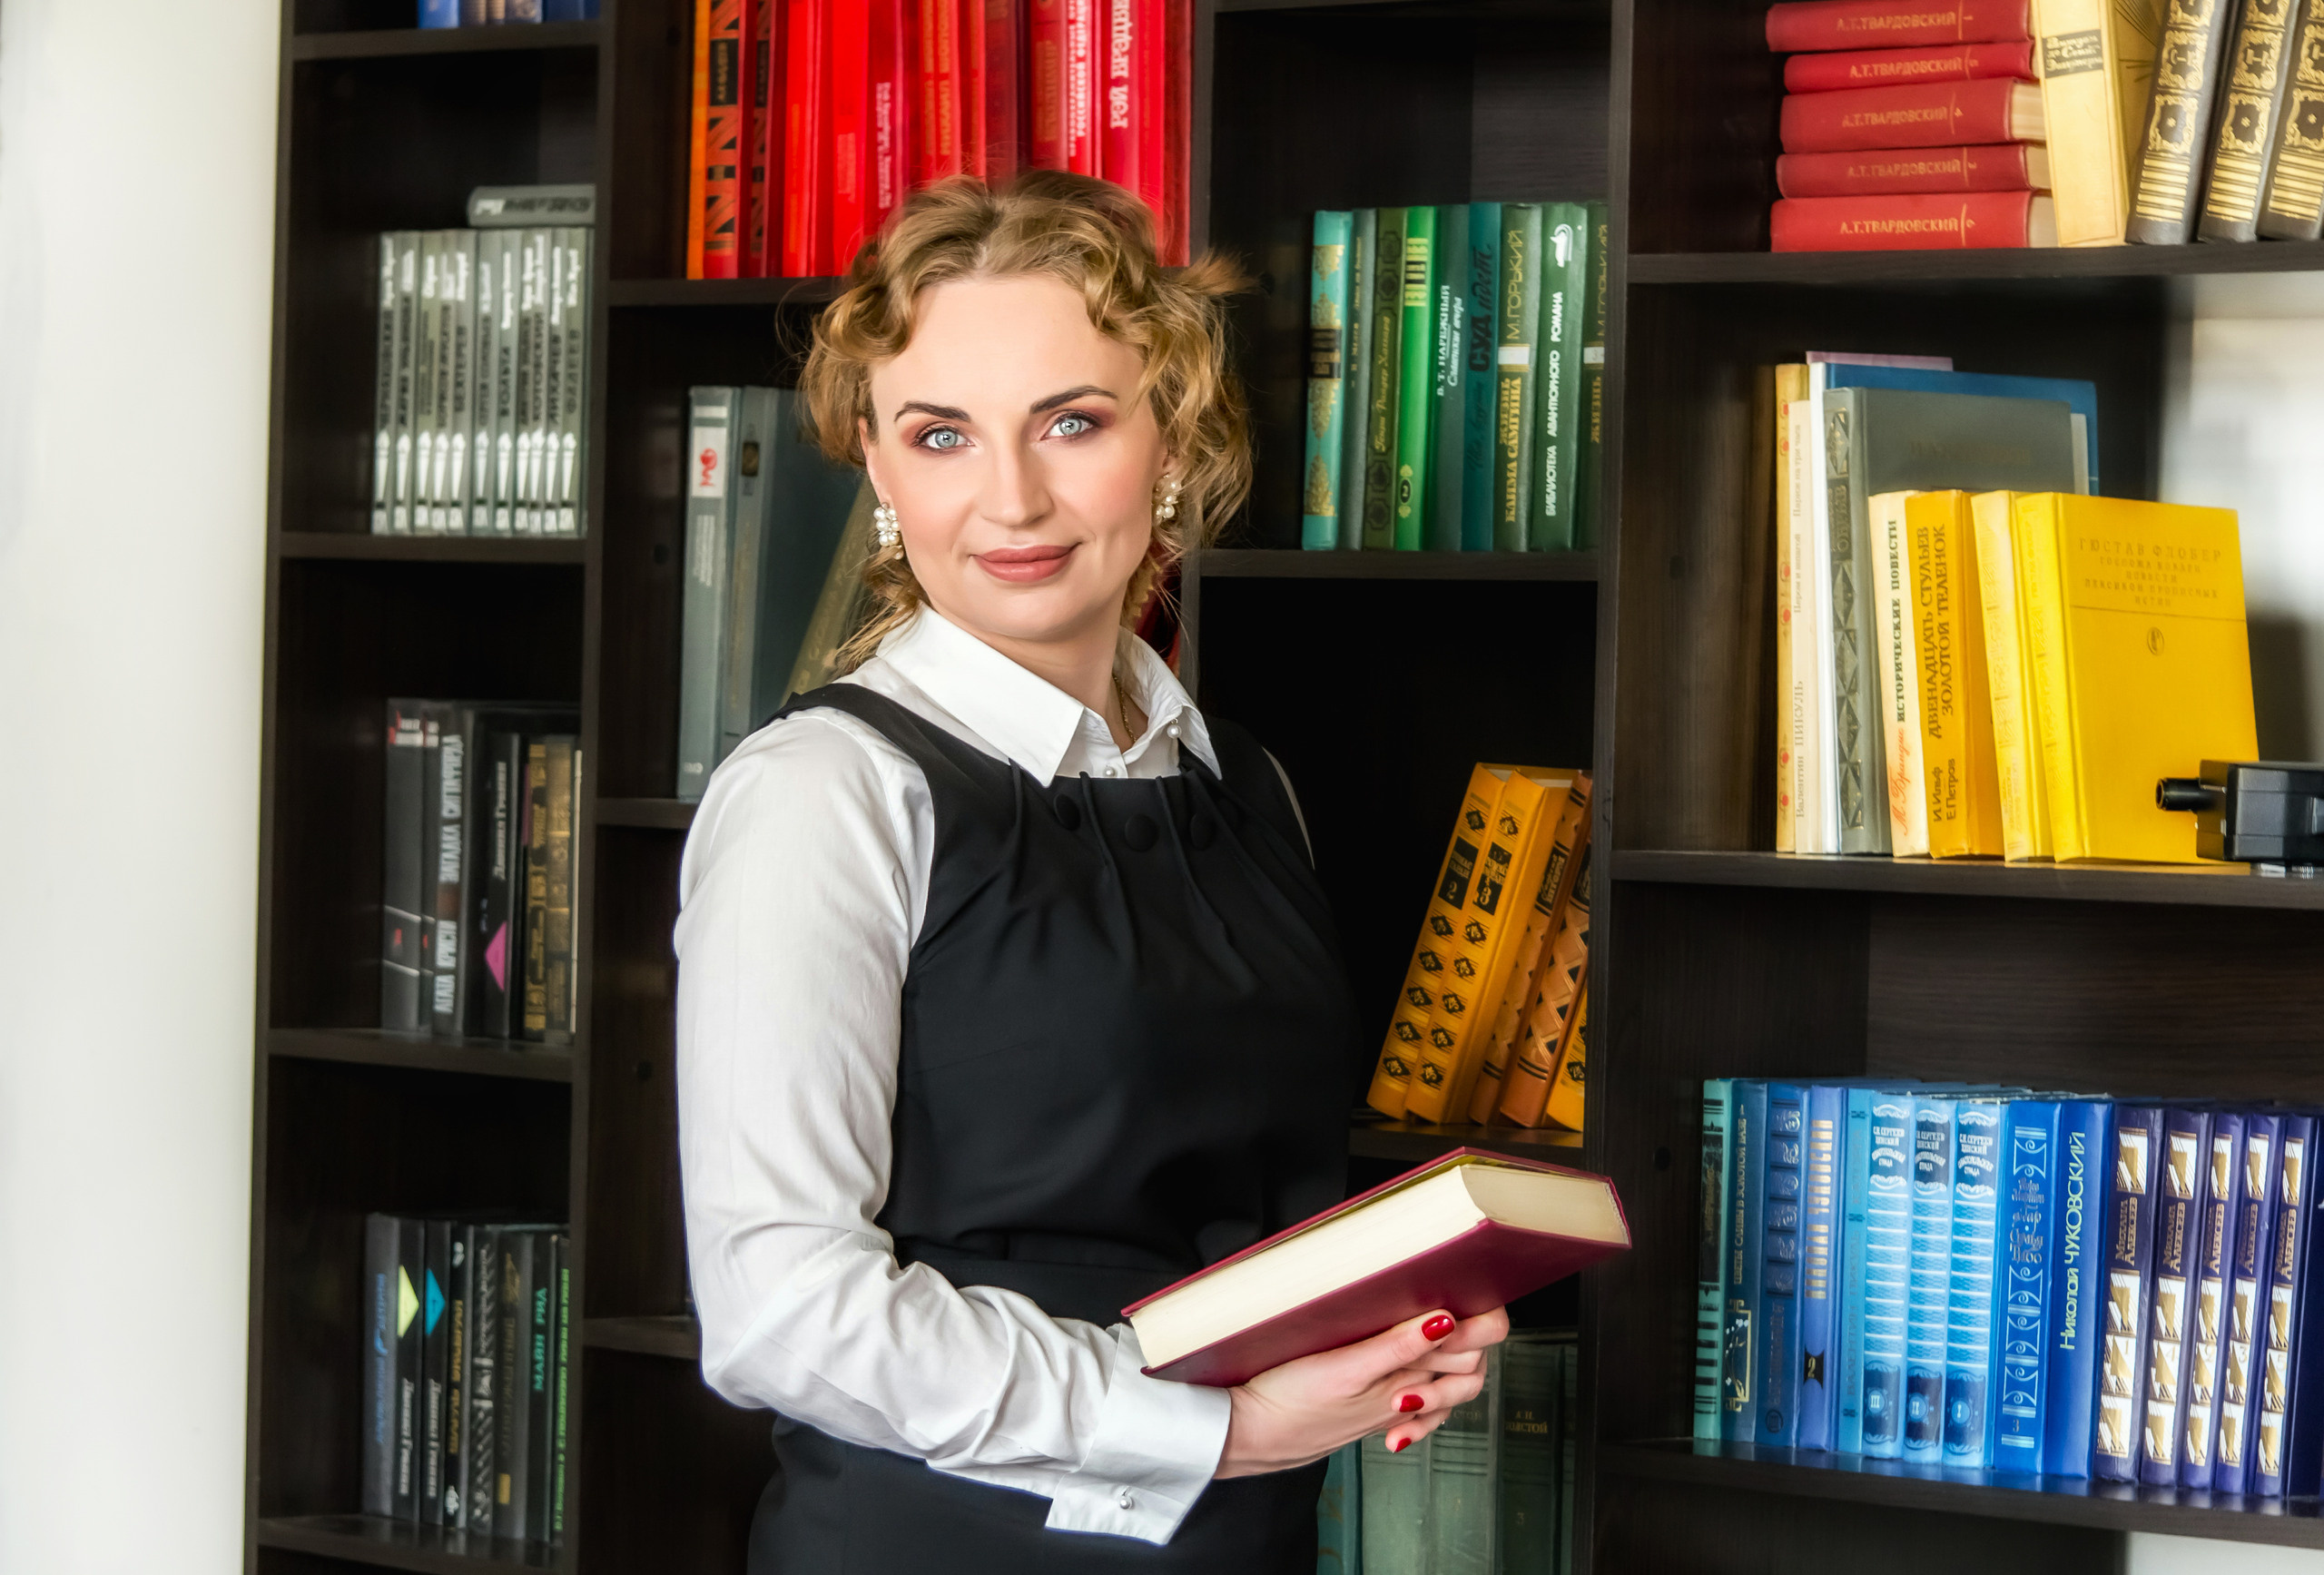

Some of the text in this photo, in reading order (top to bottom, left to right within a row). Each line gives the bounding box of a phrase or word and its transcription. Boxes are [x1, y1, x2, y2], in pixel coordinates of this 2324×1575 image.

[1109, 84, 1129, 129] РЭЙ
[1840, 217, 1959, 234] А.Т.ТВАРДОВСКИЙ
[1506, 230, 1524, 340] М.ГОРЬКИЙ
[1437, 285, 1450, 366] НАРЕЖНЫЙ
[1469, 315, 1492, 372] СУД
[1500, 378, 1511, 444] ЖИЗНЬ
[1545, 290, 1564, 517] БИБЛИОТЕКА АВАНТЮРНОГО РОМАНА
[1505, 377, 1522, 522] КЛИМА САМГИНА
[1792, 424, 1801, 446] часа
[1793, 448, 1803, 465] три
[1792, 482, 1802, 517] Париж
[1792, 534, 1803, 569] шпагой
[1886, 520, 1901, 589] ПОВЕСТИ
[2079, 537, 2221, 562] ГЮСТАВ ФЛОБЕР
[1792, 580, 1802, 614] Пером
[1933, 523, 1954, 716] ЗОЛОТОЙ ТЕЛЕНОК
[1916, 525, 1942, 740] ДВЕНАДЦАТЬ СТУЛЬЕВ
[1891, 598, 1906, 723] ИСТОРИЧЕСКИЕ
[1793, 681, 1805, 747] ПИКУЛЬ
[1794, 756, 1805, 817] Валентин
[1887, 727, 1910, 803] Брандис
[1447, 880, 1458, 900] 2
[1480, 886, 1492, 905] 3
[1737, 1118, 1747, 1145] ВАЗЕ
[1735, 1147, 1746, 1198] ЗОЛОТОЙ
[2063, 1132, 2085, 1264] ЧУКОВСКИЙ
[1735, 1210, 1745, 1247] СЛИВЫ
[1736, 1200, 1746, 1208] В
[2115, 1199, 2128, 1259] МИХАИЛ
[2124, 1196, 2138, 1267] АЛЕКСЕЕВ
[2162, 1205, 2176, 1265] МИХАИЛ
[2171, 1202, 2186, 1274] АЛЕКСЕЕВ
[2210, 1203, 2225, 1275] АЛЕКСЕЕВ
[2244, 1203, 2259, 1275] АЛЕКСЕЕВ
[2281, 1209, 2297, 1280] АЛЕКСЕЕВ
[1733, 1249, 1743, 1285] ЦВЕТЫ
[1847, 1230, 1860, 1300] ПИКУЛЬ
[534, 1286, 547, 1392] МАЙН РИД
[1846, 1305, 1859, 1396] ВАЛЕНТИН
[2124, 1344, 2130, 1355] 1
[2166, 1344, 2176, 1361] 4
[2204, 1343, 2214, 1363] 2
[2238, 1344, 2248, 1363] 3
[2277, 1354, 2287, 1371] 5
[1807, 1356, 1817, 1379] 2
[1869, 1394, 1880, 1409] III
[1911, 1401, 1920, 1414] II
[2011, 1418, 2020, 1433] 3
